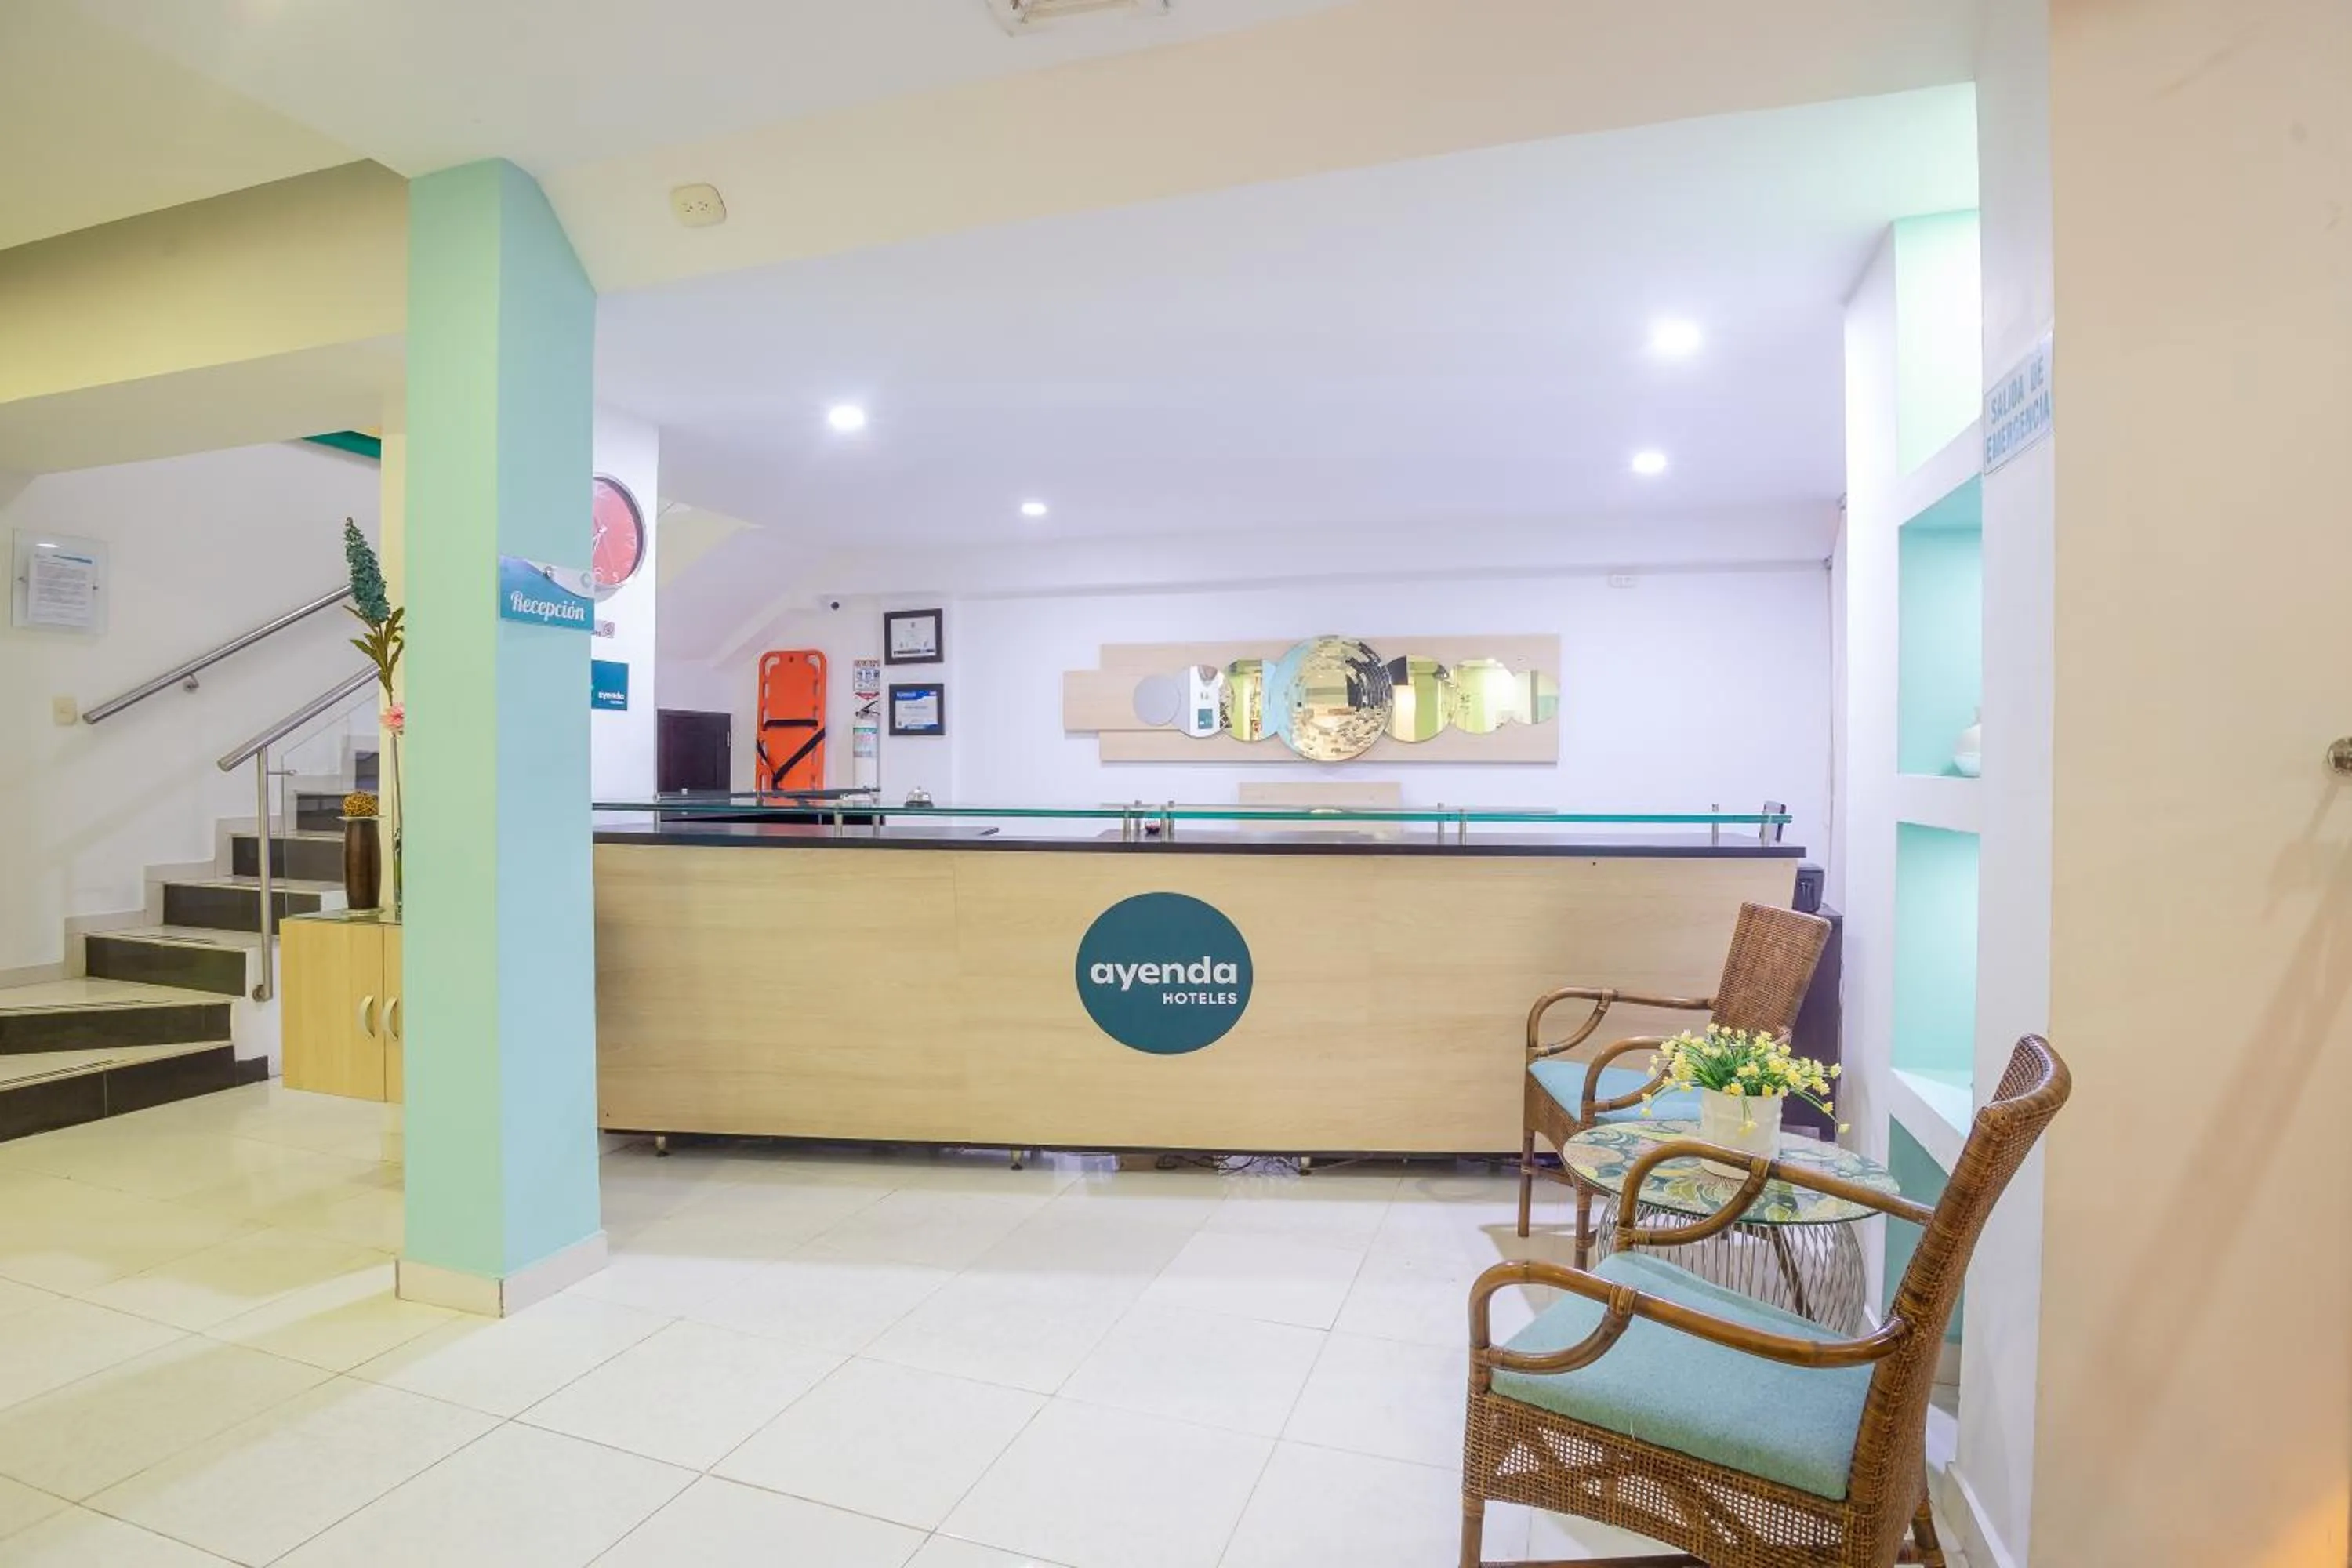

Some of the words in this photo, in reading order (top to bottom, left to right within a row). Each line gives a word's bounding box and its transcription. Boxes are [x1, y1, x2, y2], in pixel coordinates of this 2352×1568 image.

[1991, 374, 2024, 426] SALIDA
[1986, 389, 2050, 465] EMERGENCIA
[510, 590, 585, 622] Recepción
[1090, 956, 1238, 992] ayenda
[1162, 992, 1238, 1005] HOTELES
